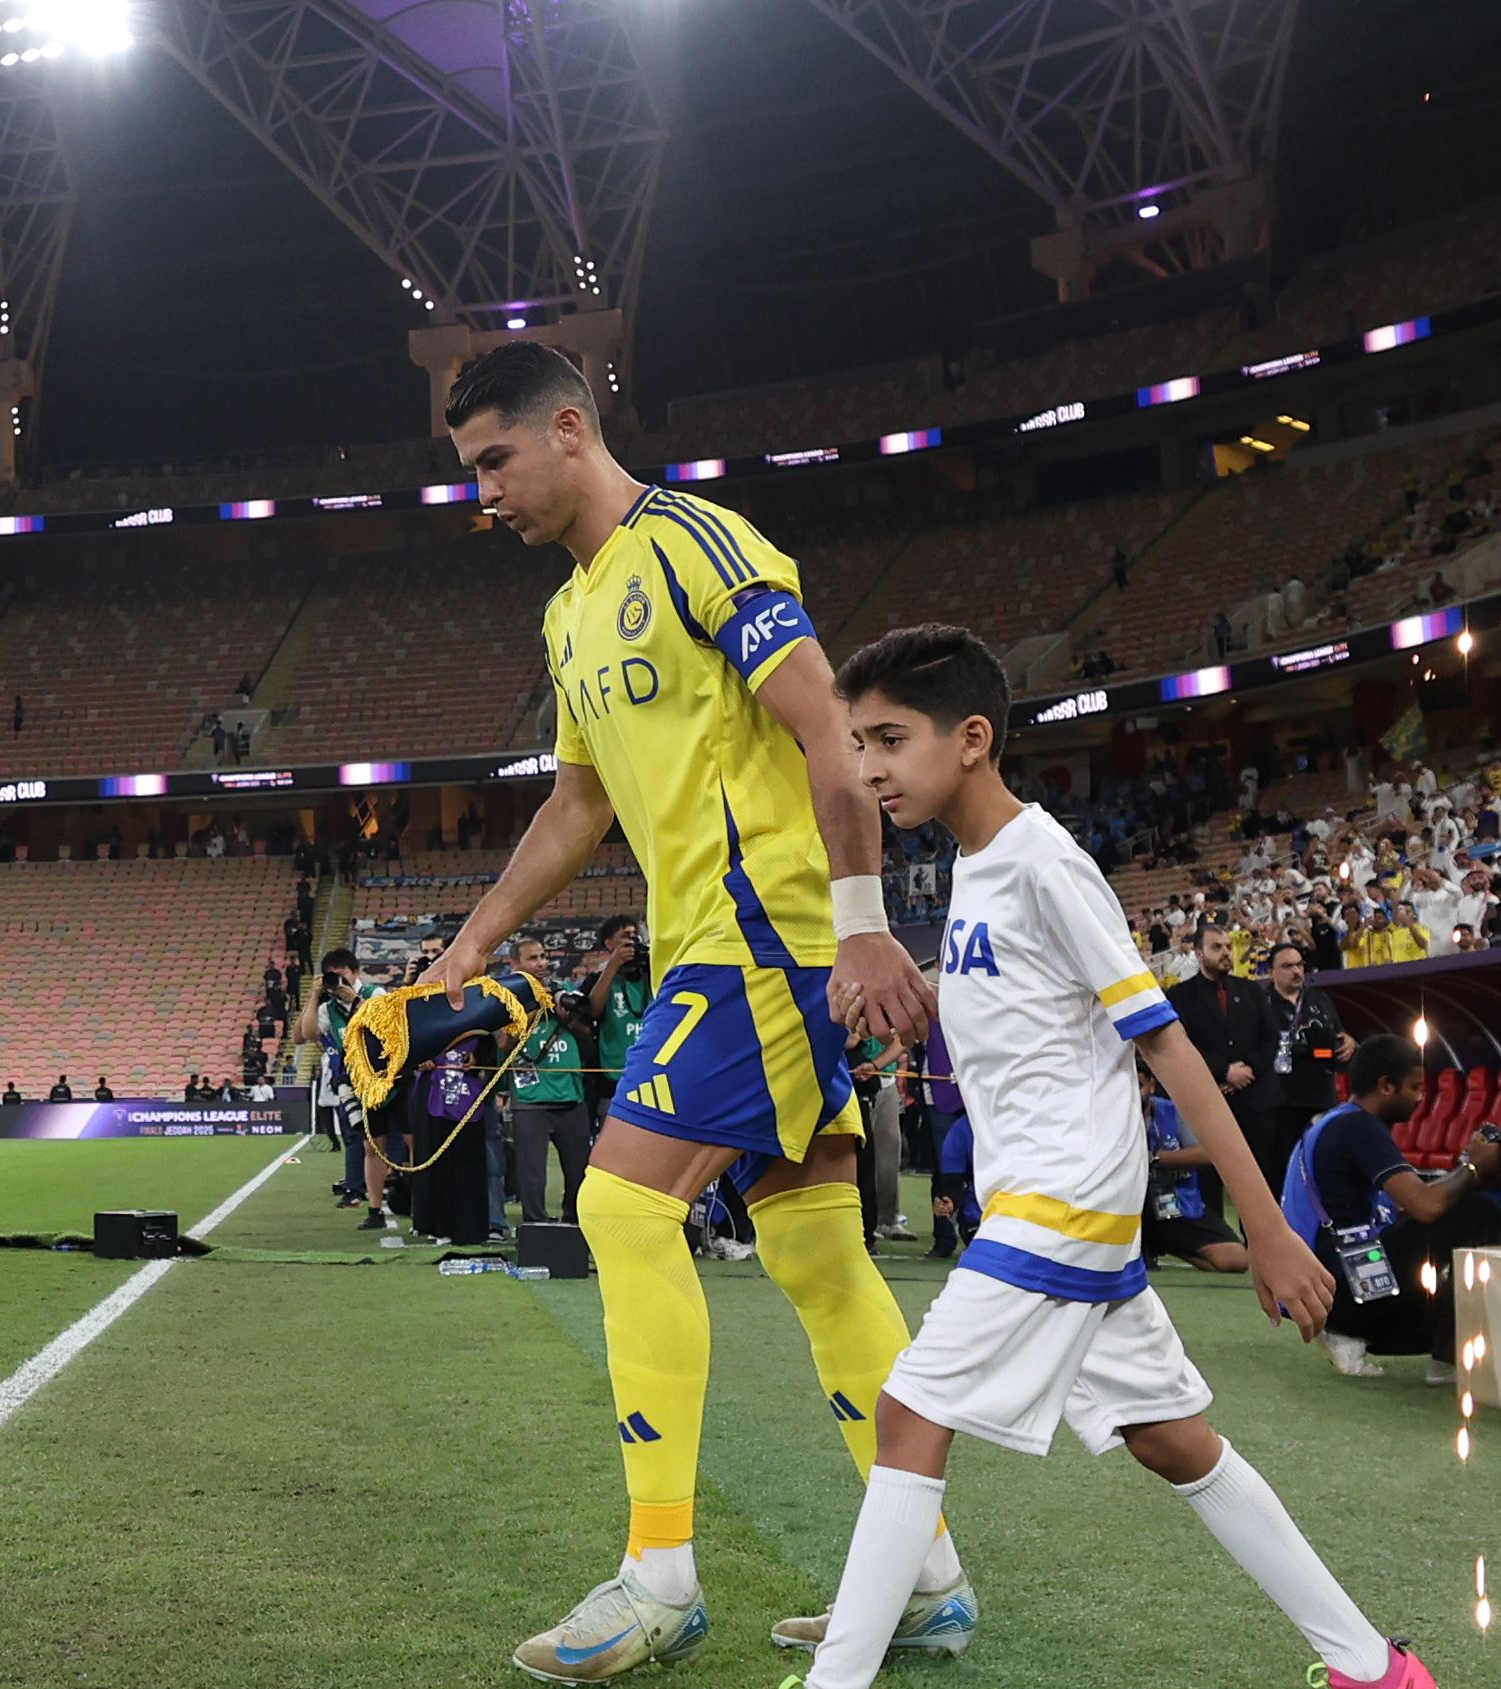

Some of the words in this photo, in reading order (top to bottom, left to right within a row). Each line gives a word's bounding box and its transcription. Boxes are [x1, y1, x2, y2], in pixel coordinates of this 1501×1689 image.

[742, 602, 798, 663] AFC
[566, 656, 660, 725] AFD
[653, 991, 708, 1066] 7
[548, 1053, 560, 1063] 71
[133, 1111, 201, 1122] CHAMPIONS
[203, 1110, 248, 1122] LEAGUE
[250, 1110, 282, 1121] ELITE
[251, 1125, 282, 1134] NEOM
